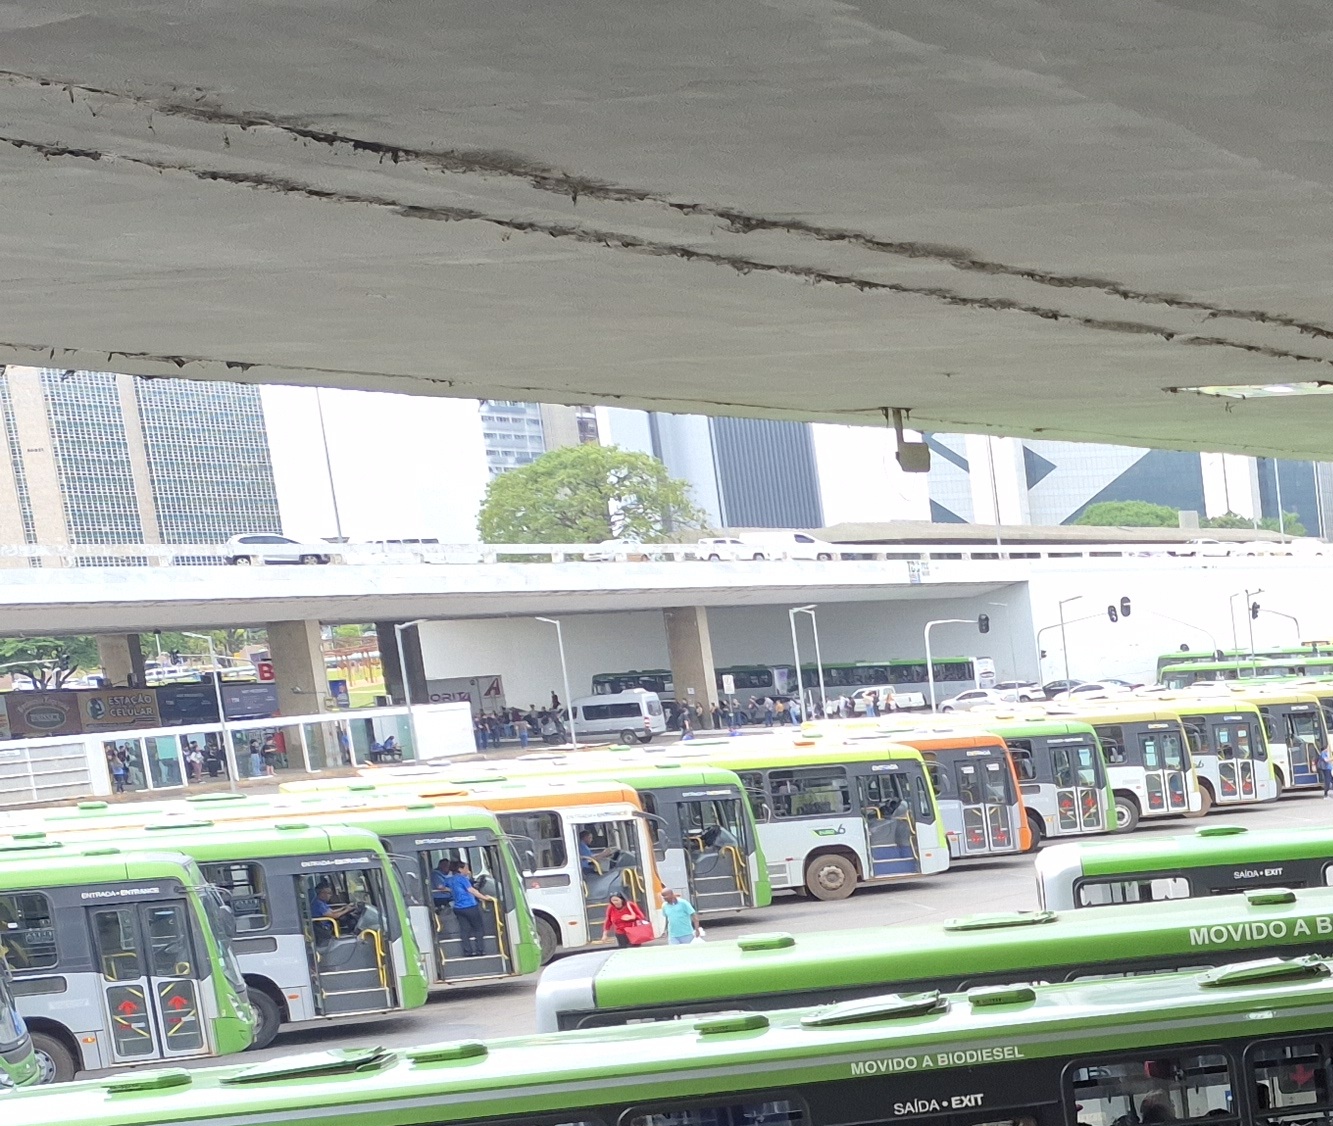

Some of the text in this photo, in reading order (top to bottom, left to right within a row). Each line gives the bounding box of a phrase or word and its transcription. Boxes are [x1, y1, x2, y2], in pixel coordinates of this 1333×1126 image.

[259, 662, 275, 680] B
[110, 707, 153, 718] CELULAR
[1234, 867, 1283, 880] SAÍDA EXIT
[81, 886, 160, 900] ENTRADA ENTRANCE
[1189, 921, 1287, 946] MOVIDO
[1293, 918, 1311, 937] A
[850, 1046, 1024, 1076] MOVIDO A BIODIESEL
[893, 1093, 984, 1116] SAÍDA EXIT
